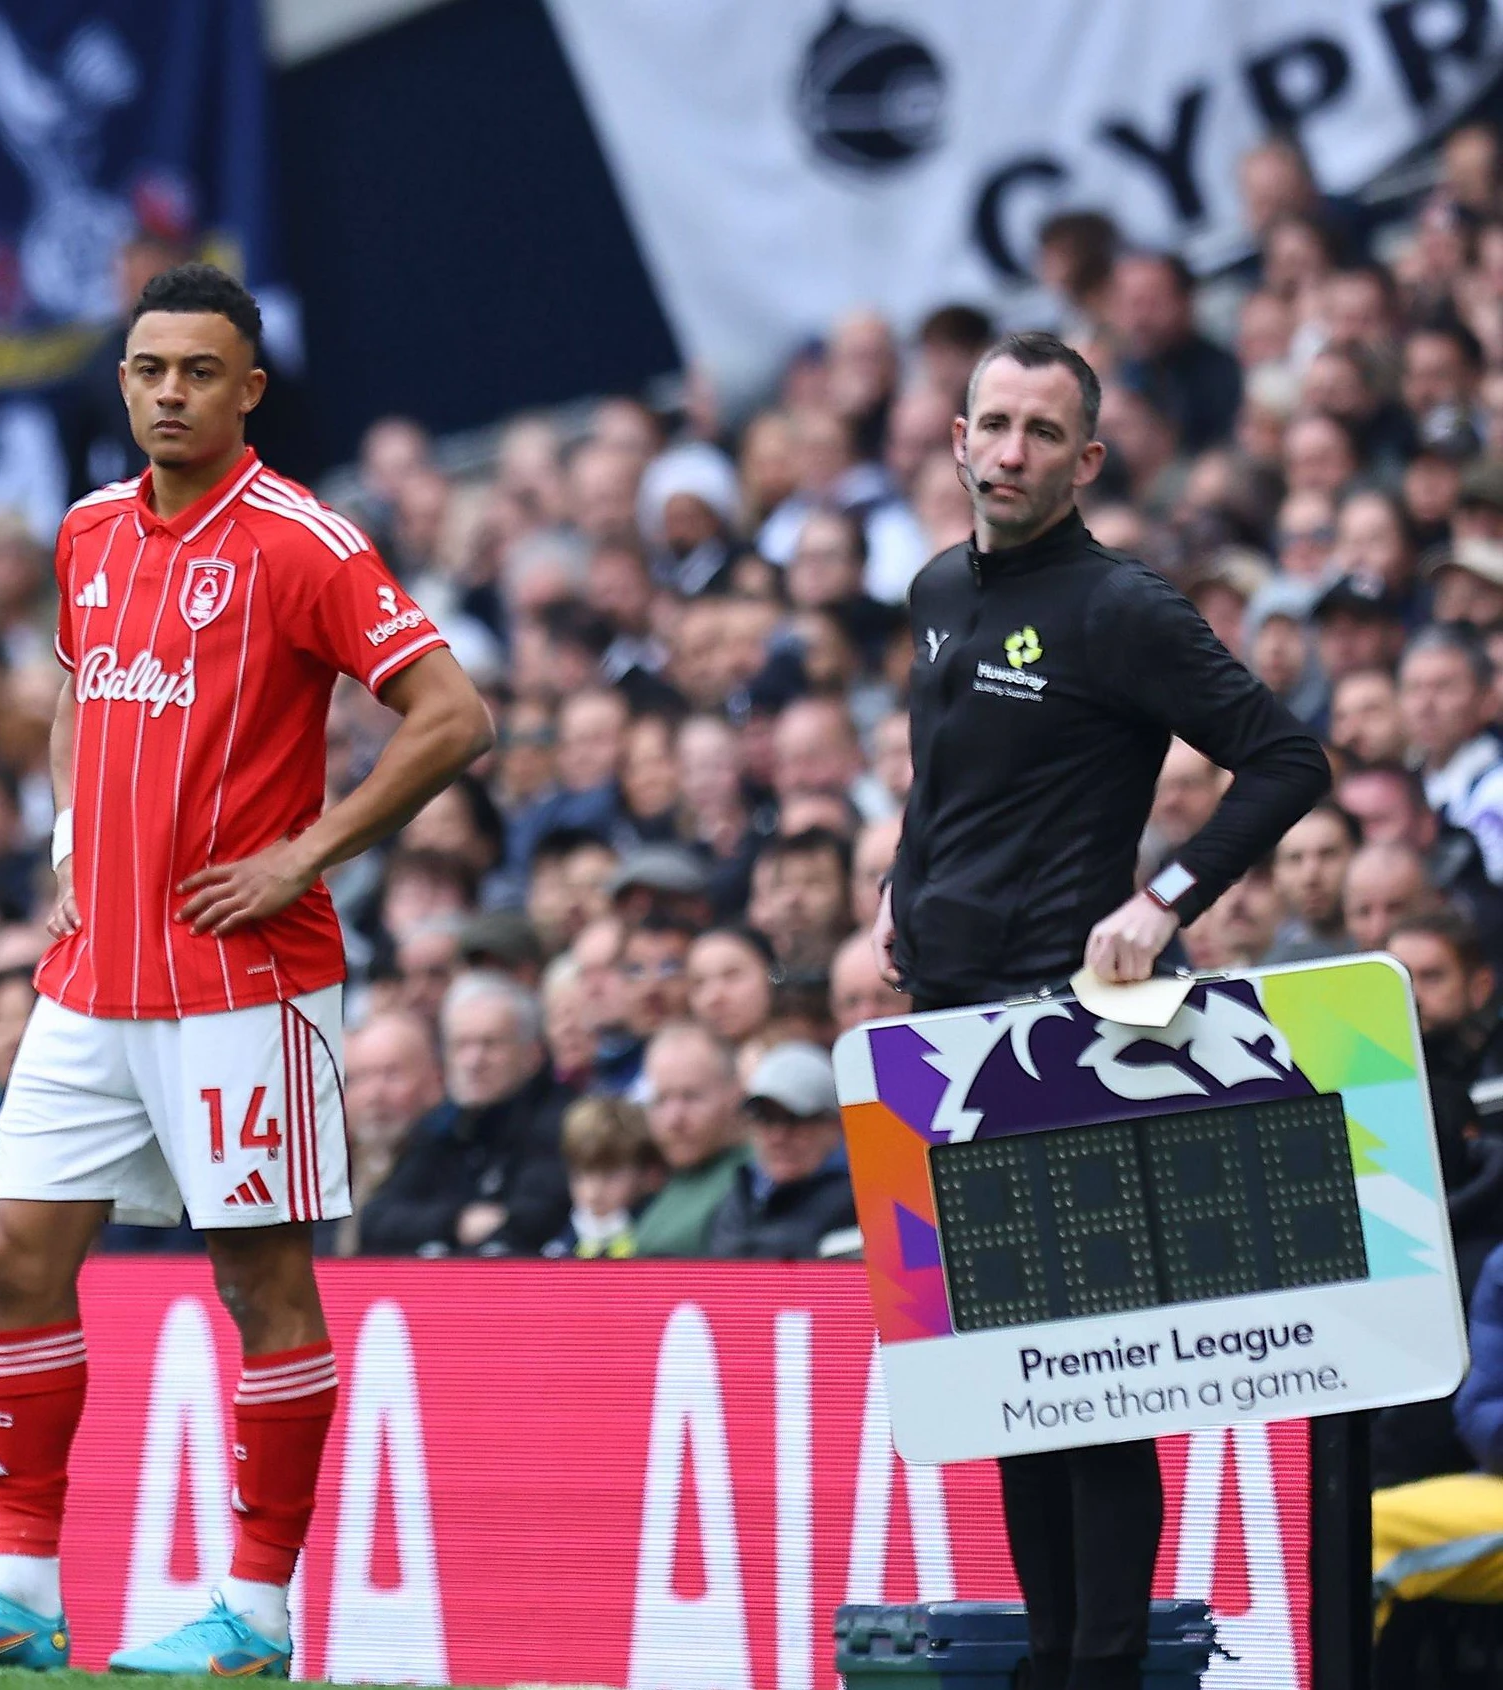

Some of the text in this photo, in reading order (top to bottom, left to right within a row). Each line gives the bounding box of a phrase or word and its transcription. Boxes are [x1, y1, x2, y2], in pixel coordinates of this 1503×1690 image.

[76, 645, 196, 718] Bally's
[200, 1086, 282, 1163] 14
[1020, 1319, 1315, 1383] Premier League
[1002, 1364, 1349, 1432] More than a game.
